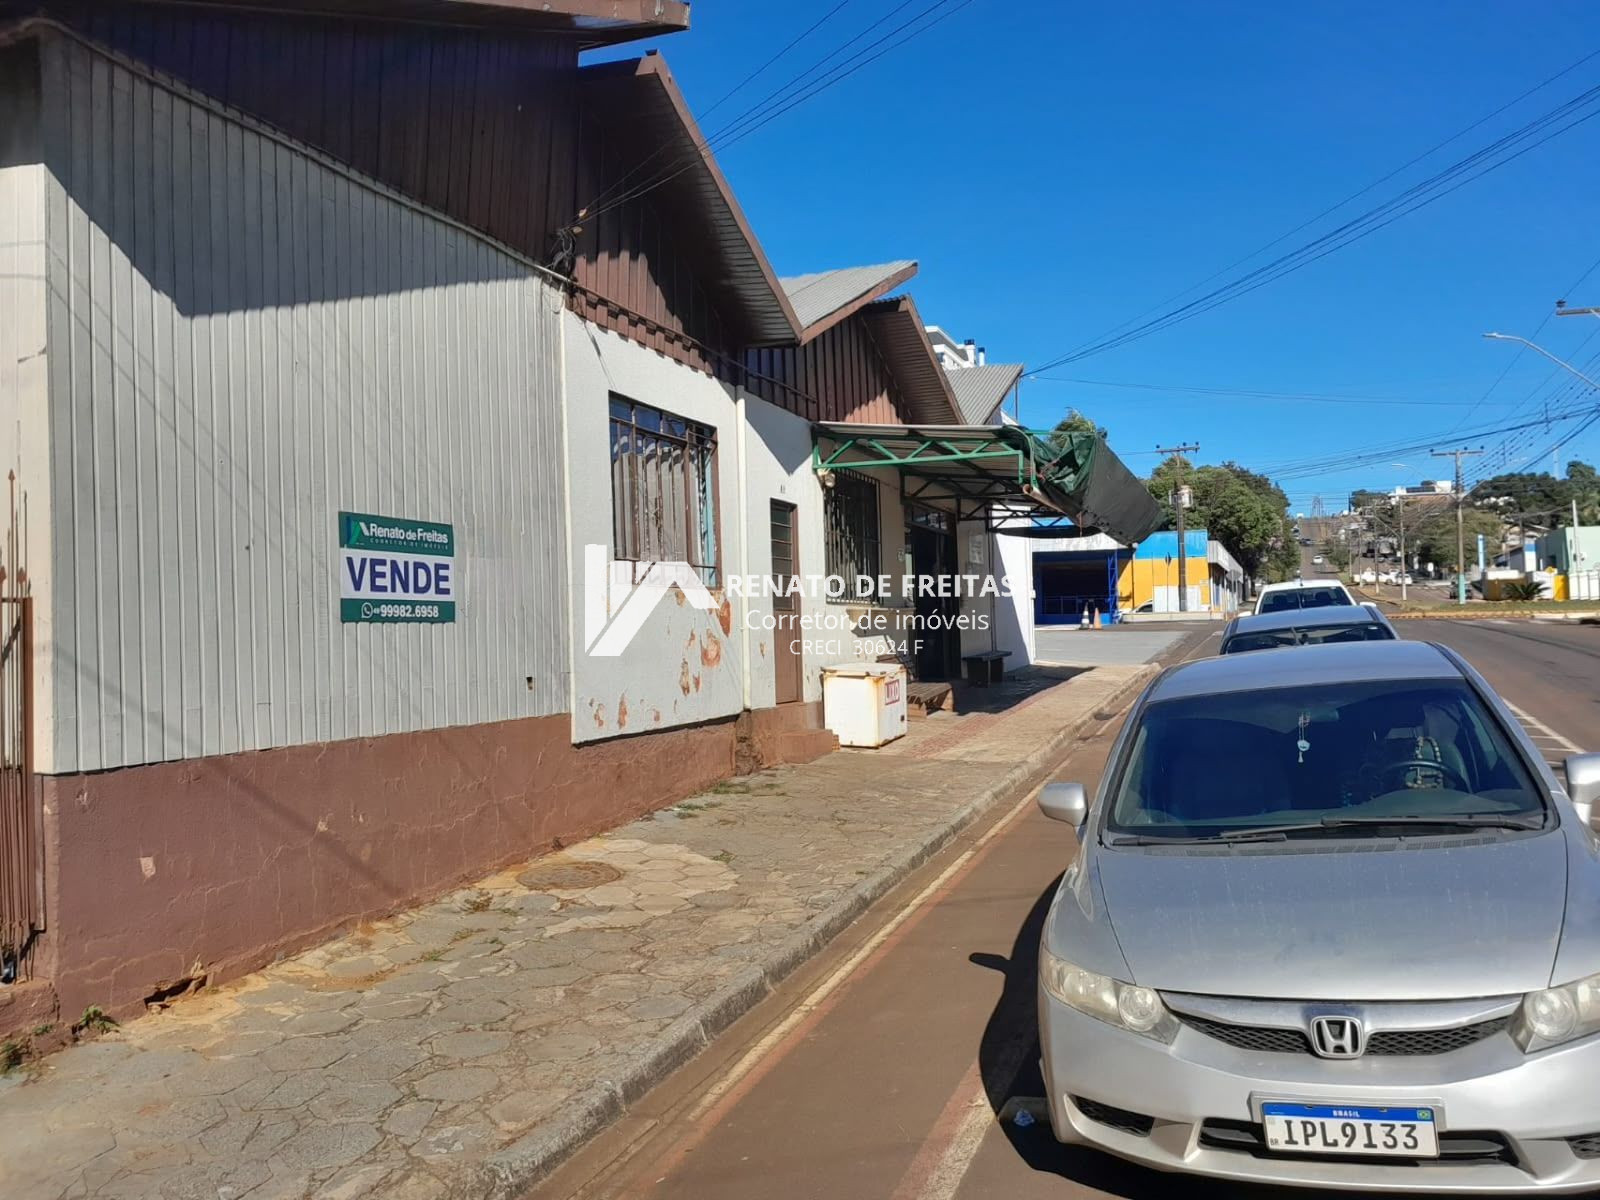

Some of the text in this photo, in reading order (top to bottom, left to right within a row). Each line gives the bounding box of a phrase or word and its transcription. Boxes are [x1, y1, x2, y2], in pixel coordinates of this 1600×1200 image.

[370, 523, 448, 543] Renato de Freitas
[346, 556, 450, 595] VENDE
[380, 604, 439, 618] 99982.6958
[1332, 1109, 1361, 1118] BRASIL
[1270, 1138, 1279, 1146] BR
[1284, 1119, 1419, 1150] IPL9I33
